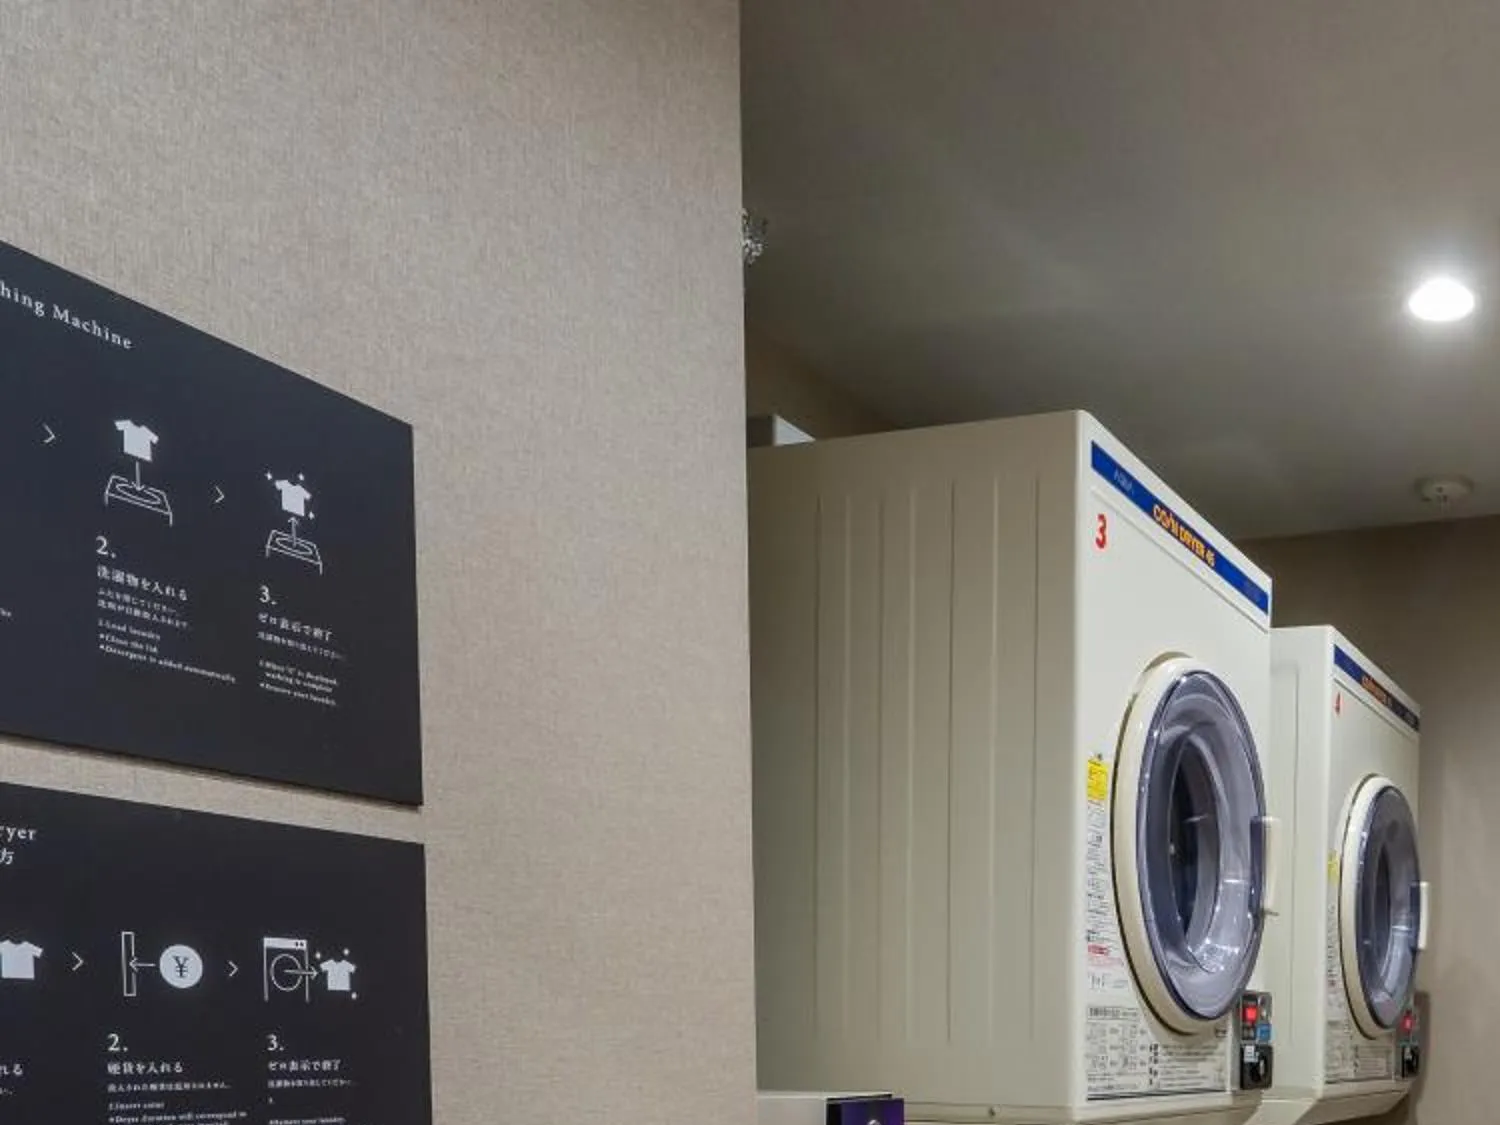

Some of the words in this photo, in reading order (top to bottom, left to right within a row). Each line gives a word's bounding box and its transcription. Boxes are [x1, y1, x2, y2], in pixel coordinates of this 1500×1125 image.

[53, 303, 133, 349] Machine
[1096, 513, 1107, 549] 3
[96, 535, 117, 558] 2.
[97, 565, 188, 601] 洗濯物を入れる
[259, 585, 278, 605] 3.
[107, 1033, 128, 1052] 2.
[266, 1034, 284, 1051] 3.
[107, 1061, 183, 1075] 硬貨を入れる
